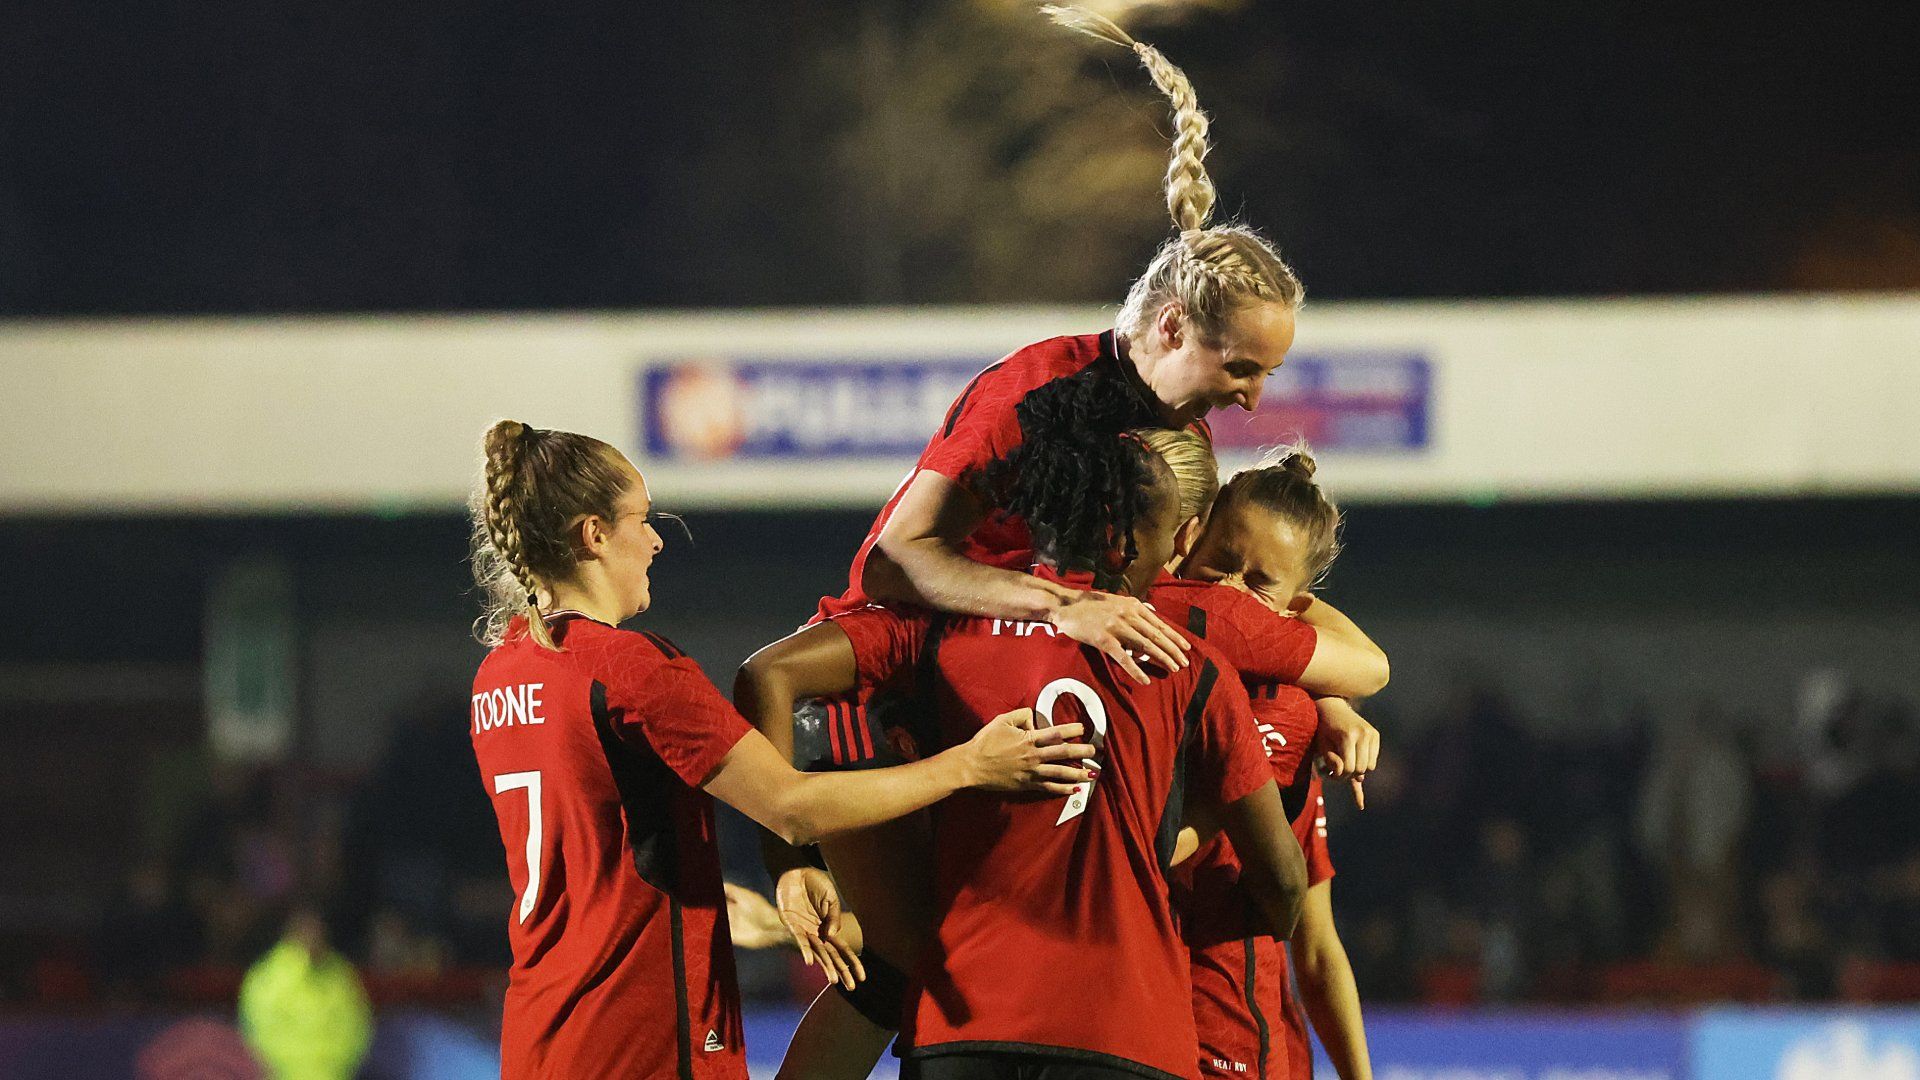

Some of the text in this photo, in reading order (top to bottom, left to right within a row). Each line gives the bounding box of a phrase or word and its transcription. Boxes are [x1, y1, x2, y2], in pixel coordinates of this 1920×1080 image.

[472, 683, 546, 735] TOONE
[1035, 677, 1107, 827] 9
[493, 769, 543, 925] 7
